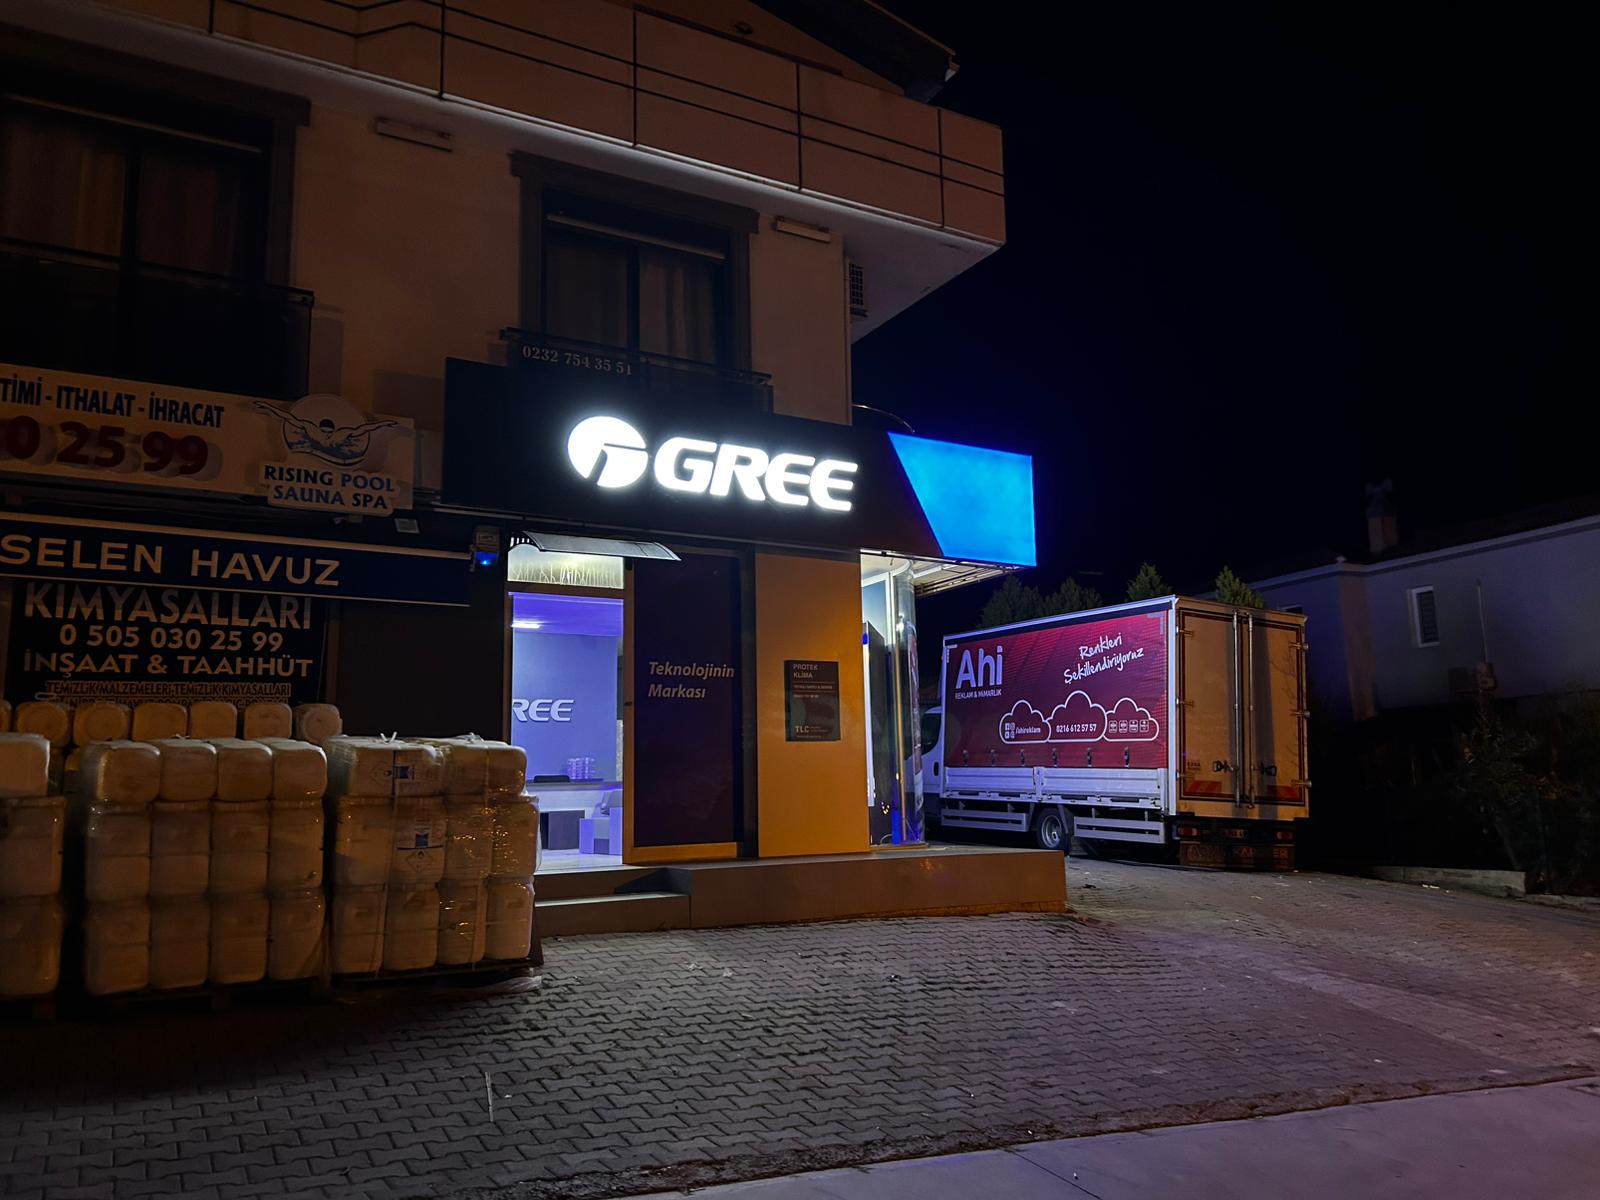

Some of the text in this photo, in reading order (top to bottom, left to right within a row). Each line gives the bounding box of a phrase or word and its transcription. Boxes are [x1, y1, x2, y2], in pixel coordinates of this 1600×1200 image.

[522, 345, 633, 376] 0232 754 35 51
[149, 392, 225, 428] İHRACAT
[56, 421, 125, 467] 25
[142, 431, 209, 474] 99
[264, 465, 395, 492] RISING POOL
[654, 436, 858, 512] GREE
[273, 485, 388, 509] SAUNA SPA
[0, 533, 340, 587] SELEN HAVUZ
[59, 623, 284, 652] 0 505 030 25 99
[1079, 632, 1122, 660] Renkleri
[24, 648, 313, 678] İNŞAAT & TAAHHÜT
[648, 661, 735, 680] Teknolojinin
[955, 645, 1003, 689] Ahi
[648, 683, 706, 699] Markası
